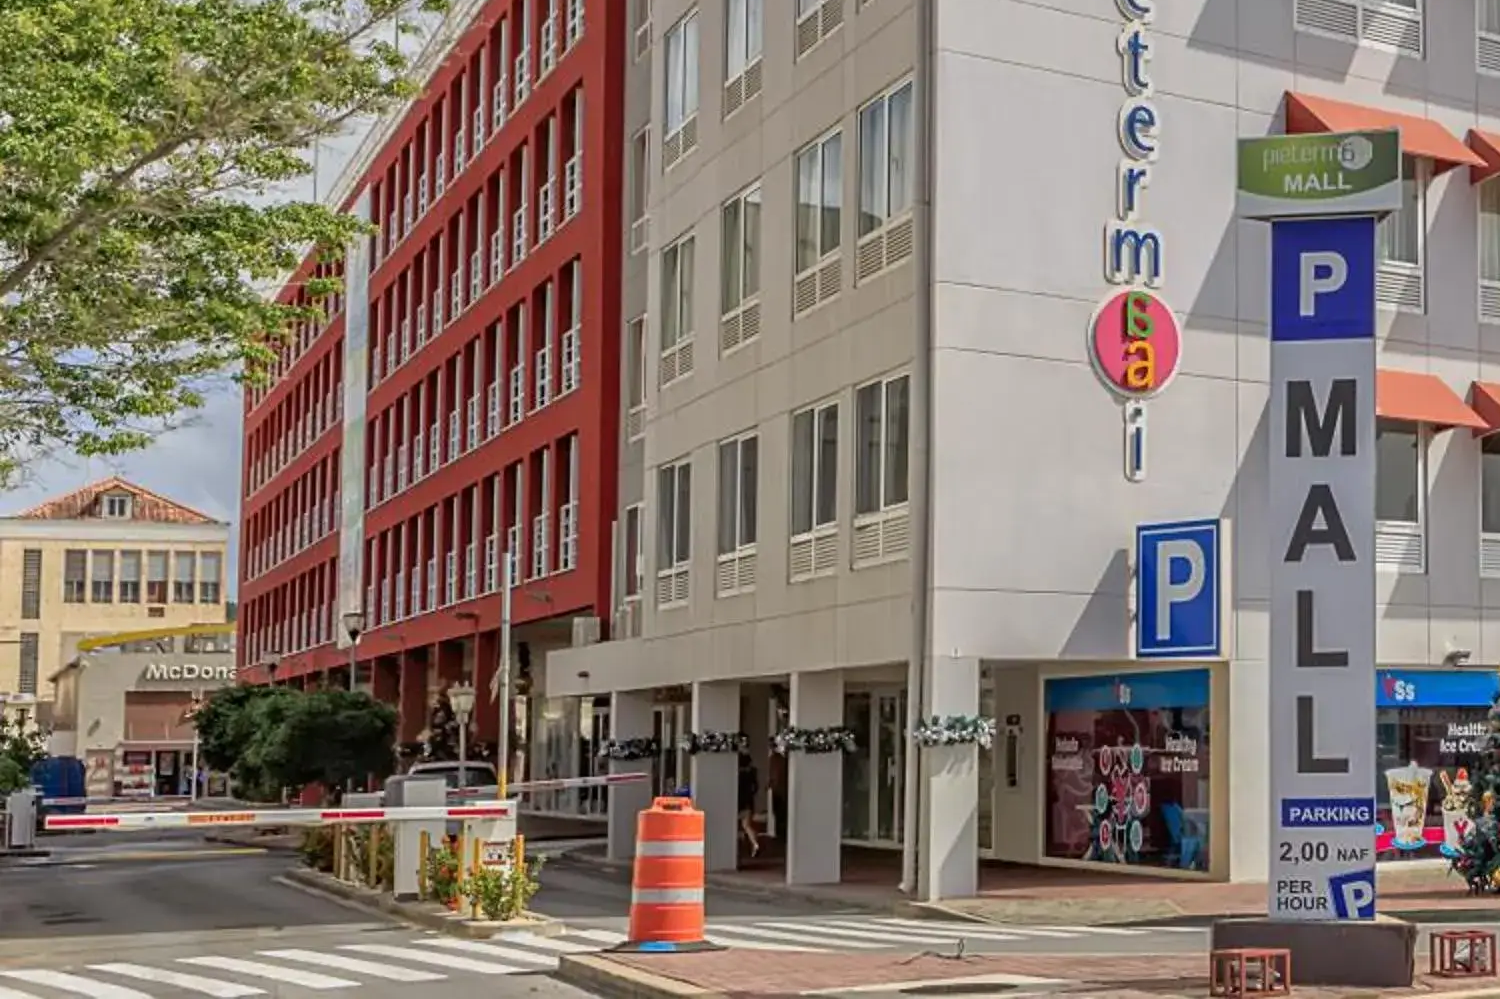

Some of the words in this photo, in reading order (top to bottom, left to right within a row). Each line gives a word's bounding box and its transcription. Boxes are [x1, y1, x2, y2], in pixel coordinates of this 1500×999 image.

[1284, 172, 1353, 194] MALL
[1299, 251, 1348, 317] P
[1284, 378, 1358, 774] MALL
[1156, 538, 1206, 641] P
[1439, 738, 1457, 753] Ice
[1289, 806, 1370, 822] PARKING
[1279, 841, 1329, 864] 2,00
[1337, 848, 1369, 862] NAF
[1277, 880, 1313, 894] PER
[1277, 896, 1328, 911] HOUR
[1342, 880, 1373, 919] P
